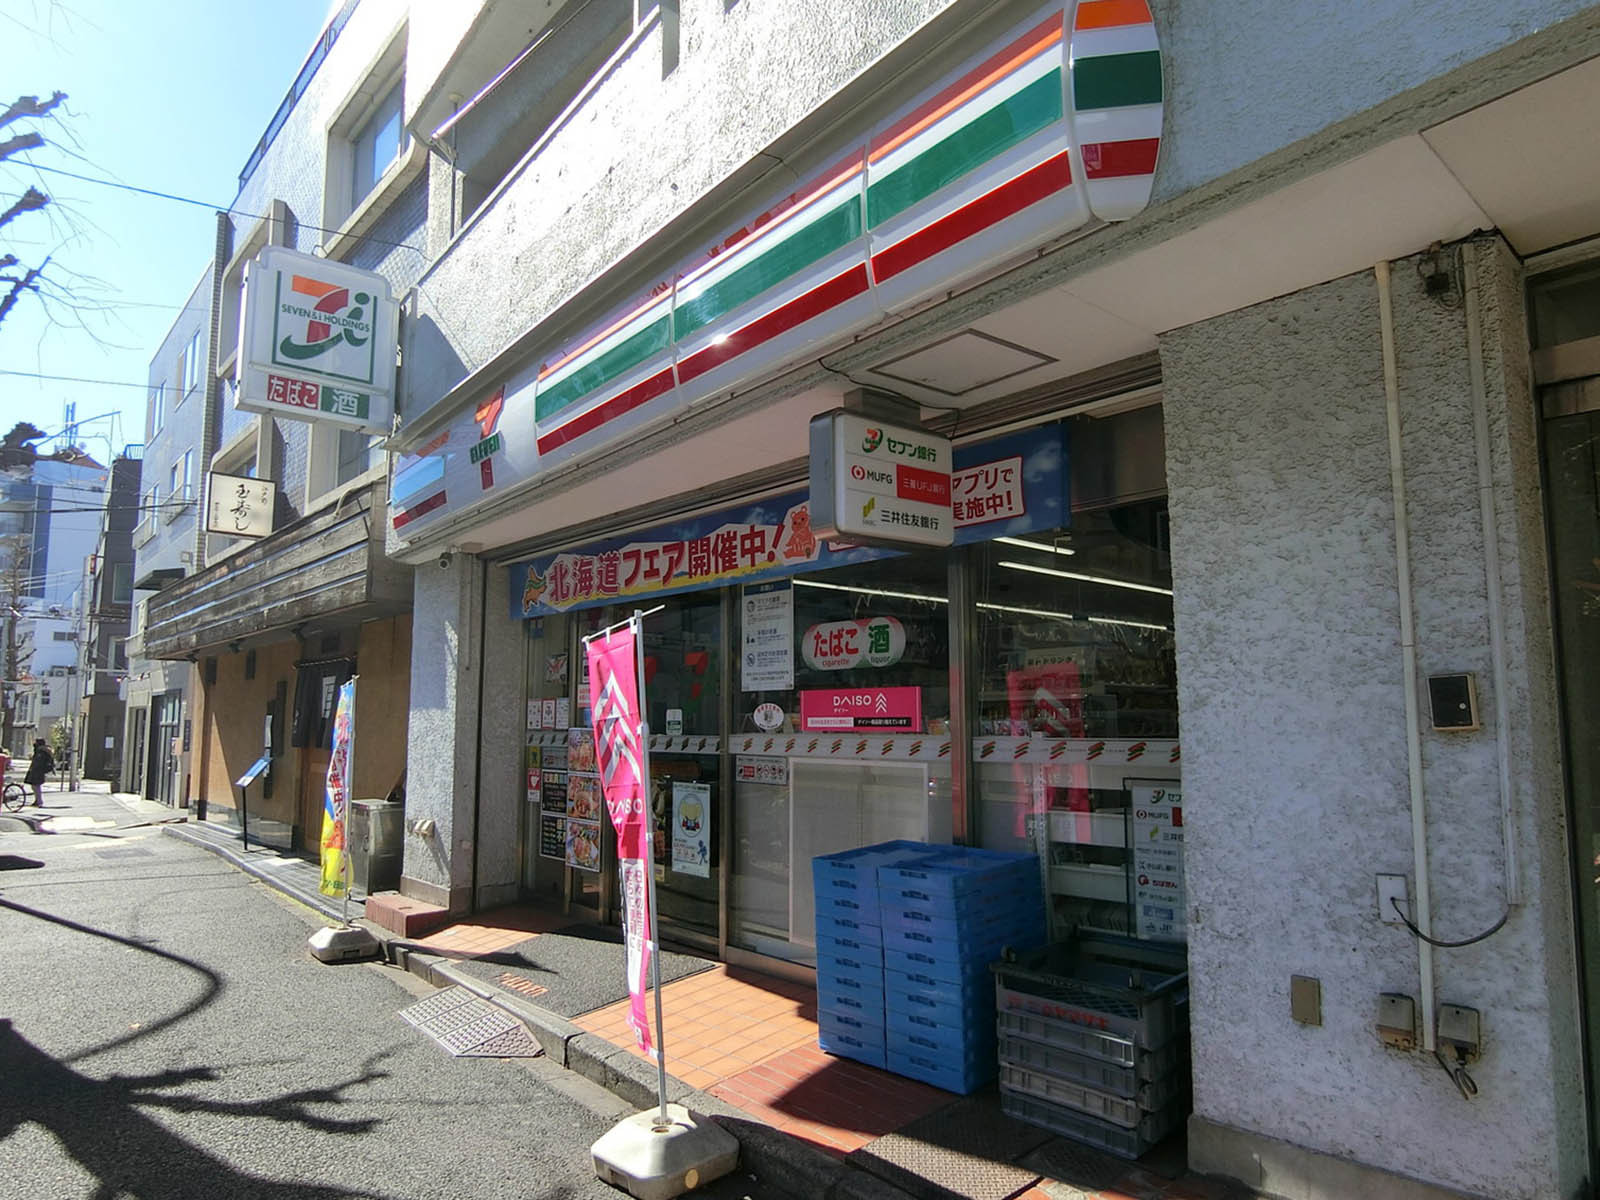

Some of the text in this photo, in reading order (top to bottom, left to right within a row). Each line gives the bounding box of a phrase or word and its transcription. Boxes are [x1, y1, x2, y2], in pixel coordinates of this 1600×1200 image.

[323, 314, 370, 333] HOLDINGS
[269, 377, 360, 416] たばこ 酒
[886, 437, 937, 463] セブン銀行
[867, 470, 892, 485] MUFG
[881, 510, 939, 531] 三井住友銀行
[548, 524, 786, 601] 北海道フェア開催中!
[813, 627, 860, 658] たばこ
[868, 624, 890, 653] 酒
[822, 655, 890, 668] cigarette liquor
[833, 695, 872, 707] DAISO
